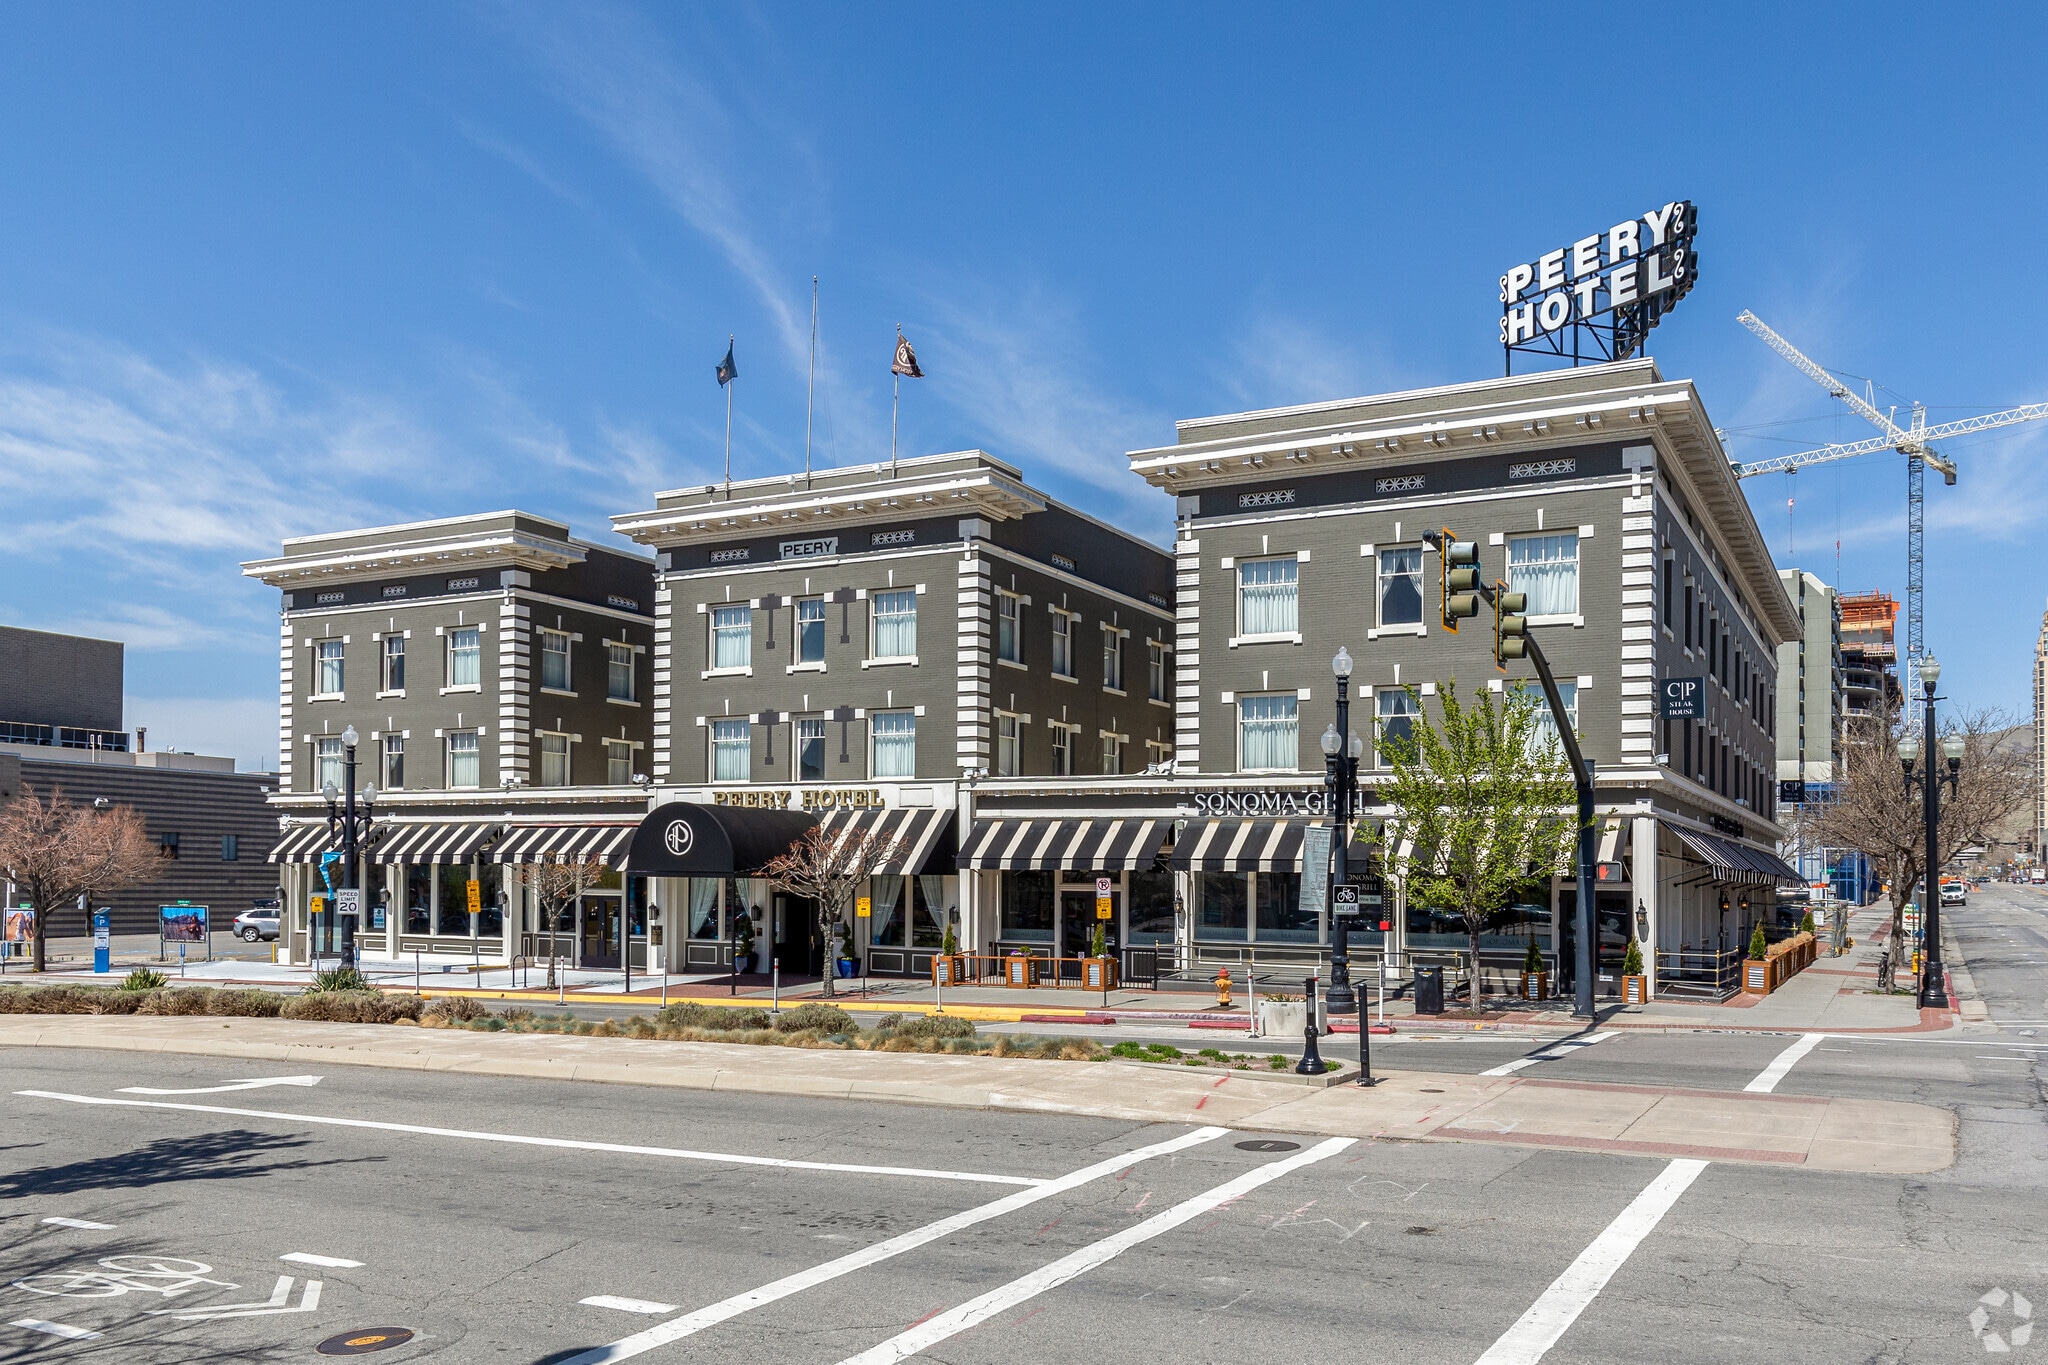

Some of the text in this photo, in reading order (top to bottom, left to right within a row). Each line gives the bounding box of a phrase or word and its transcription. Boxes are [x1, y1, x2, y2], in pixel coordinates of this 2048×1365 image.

[1507, 201, 1676, 304] PEERY
[1508, 253, 1674, 345] HOTEL
[784, 541, 833, 557] PEERY
[713, 789, 885, 808] PEERY HOTEL
[1194, 793, 1299, 812] SONOMA
[340, 902, 357, 912] 20
